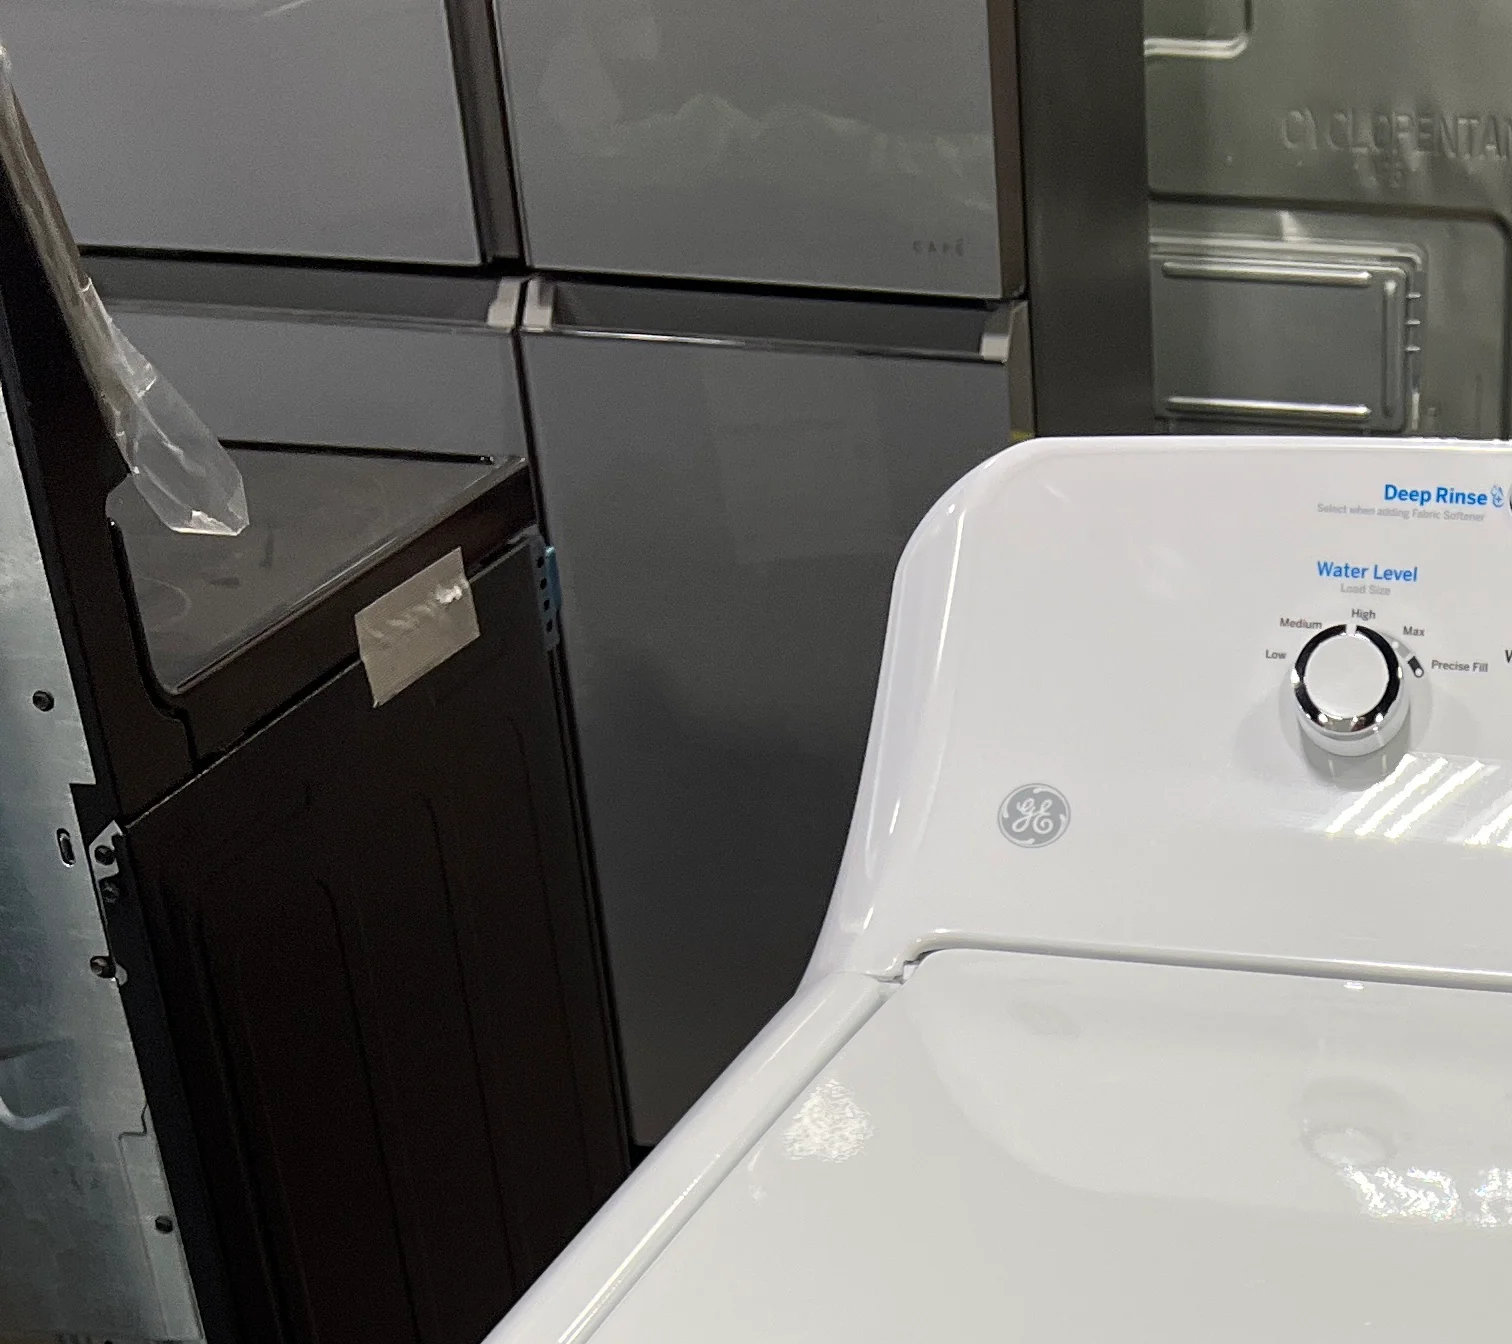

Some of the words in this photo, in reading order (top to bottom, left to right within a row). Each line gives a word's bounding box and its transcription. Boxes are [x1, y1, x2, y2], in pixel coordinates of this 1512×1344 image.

[1384, 484, 1431, 506] Deep
[1436, 487, 1488, 506] Rinse
[1317, 503, 1347, 515] Select
[1349, 506, 1375, 516] when
[1377, 507, 1410, 520] adding
[1412, 508, 1441, 520] Fabric
[1443, 510, 1485, 522] Softener
[1317, 561, 1368, 579] Water
[1373, 564, 1418, 582] Level
[1340, 583, 1366, 594] Load
[1368, 585, 1391, 596] Size
[1351, 608, 1376, 621] High
[1279, 617, 1322, 630] Medium
[1403, 625, 1425, 637] Max
[1265, 649, 1287, 660] Low
[1431, 659, 1470, 672] Precise
[1472, 662, 1488, 673] Fill
